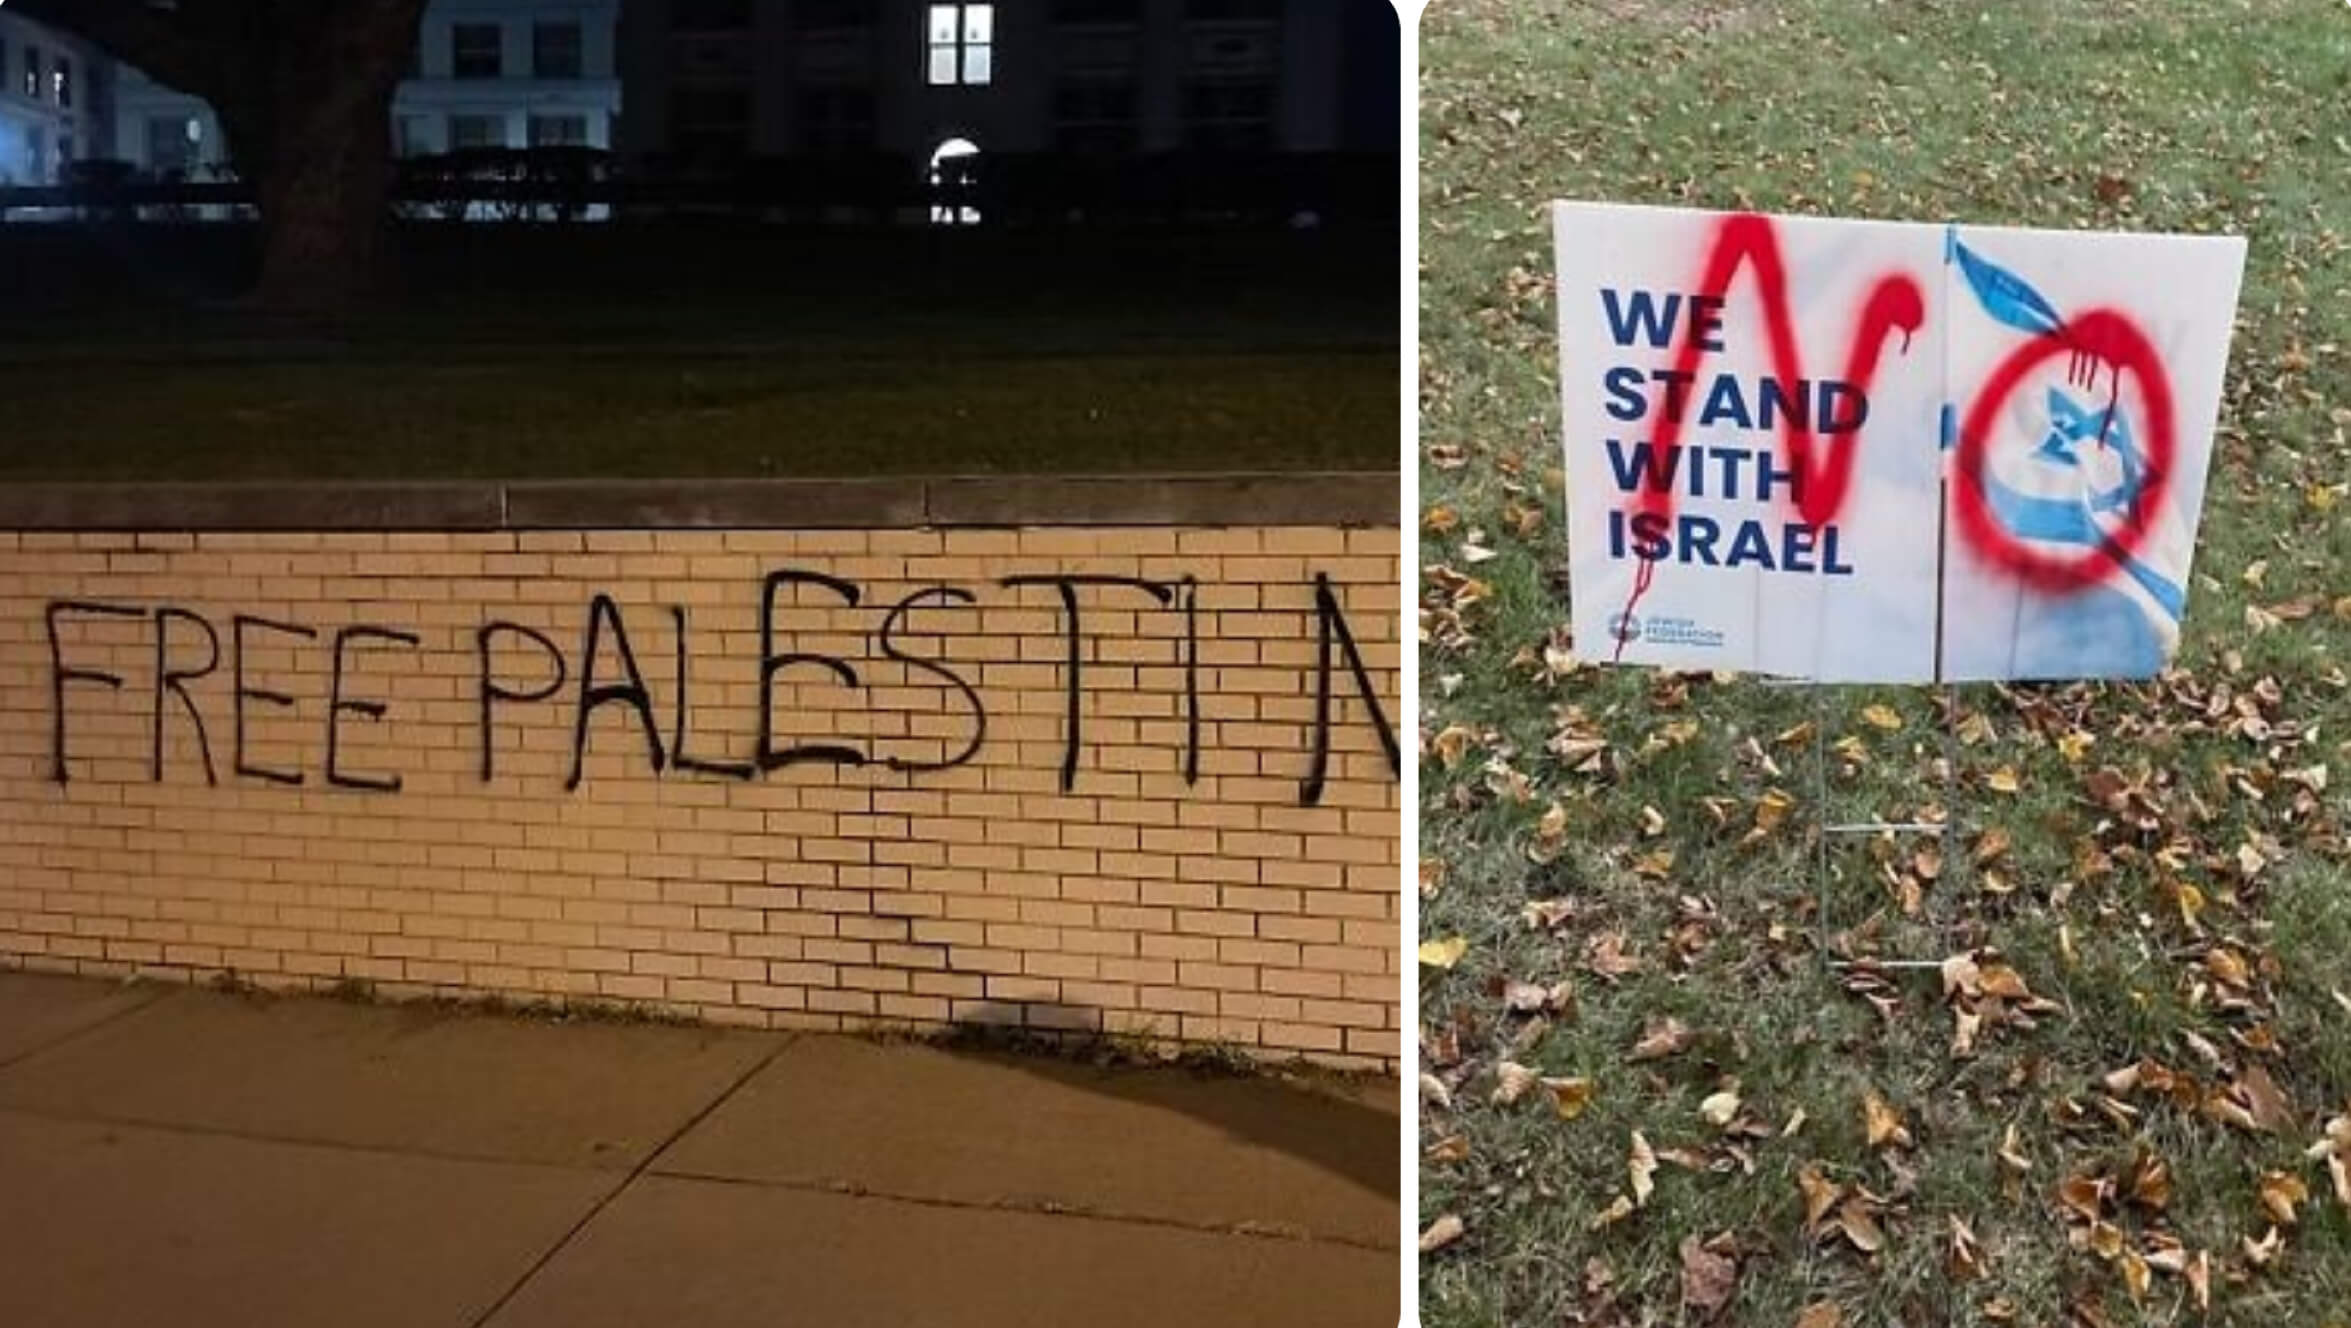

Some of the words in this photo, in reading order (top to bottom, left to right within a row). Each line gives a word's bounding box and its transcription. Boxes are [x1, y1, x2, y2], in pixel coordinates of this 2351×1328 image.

[1600, 287, 1726, 353] WE
[1605, 366, 1870, 436] STAND
[1630, 212, 2178, 596] NO
[1606, 440, 1806, 505] WITH
[1608, 510, 1854, 576] ISRAEL
[46, 602, 420, 792] FREE
